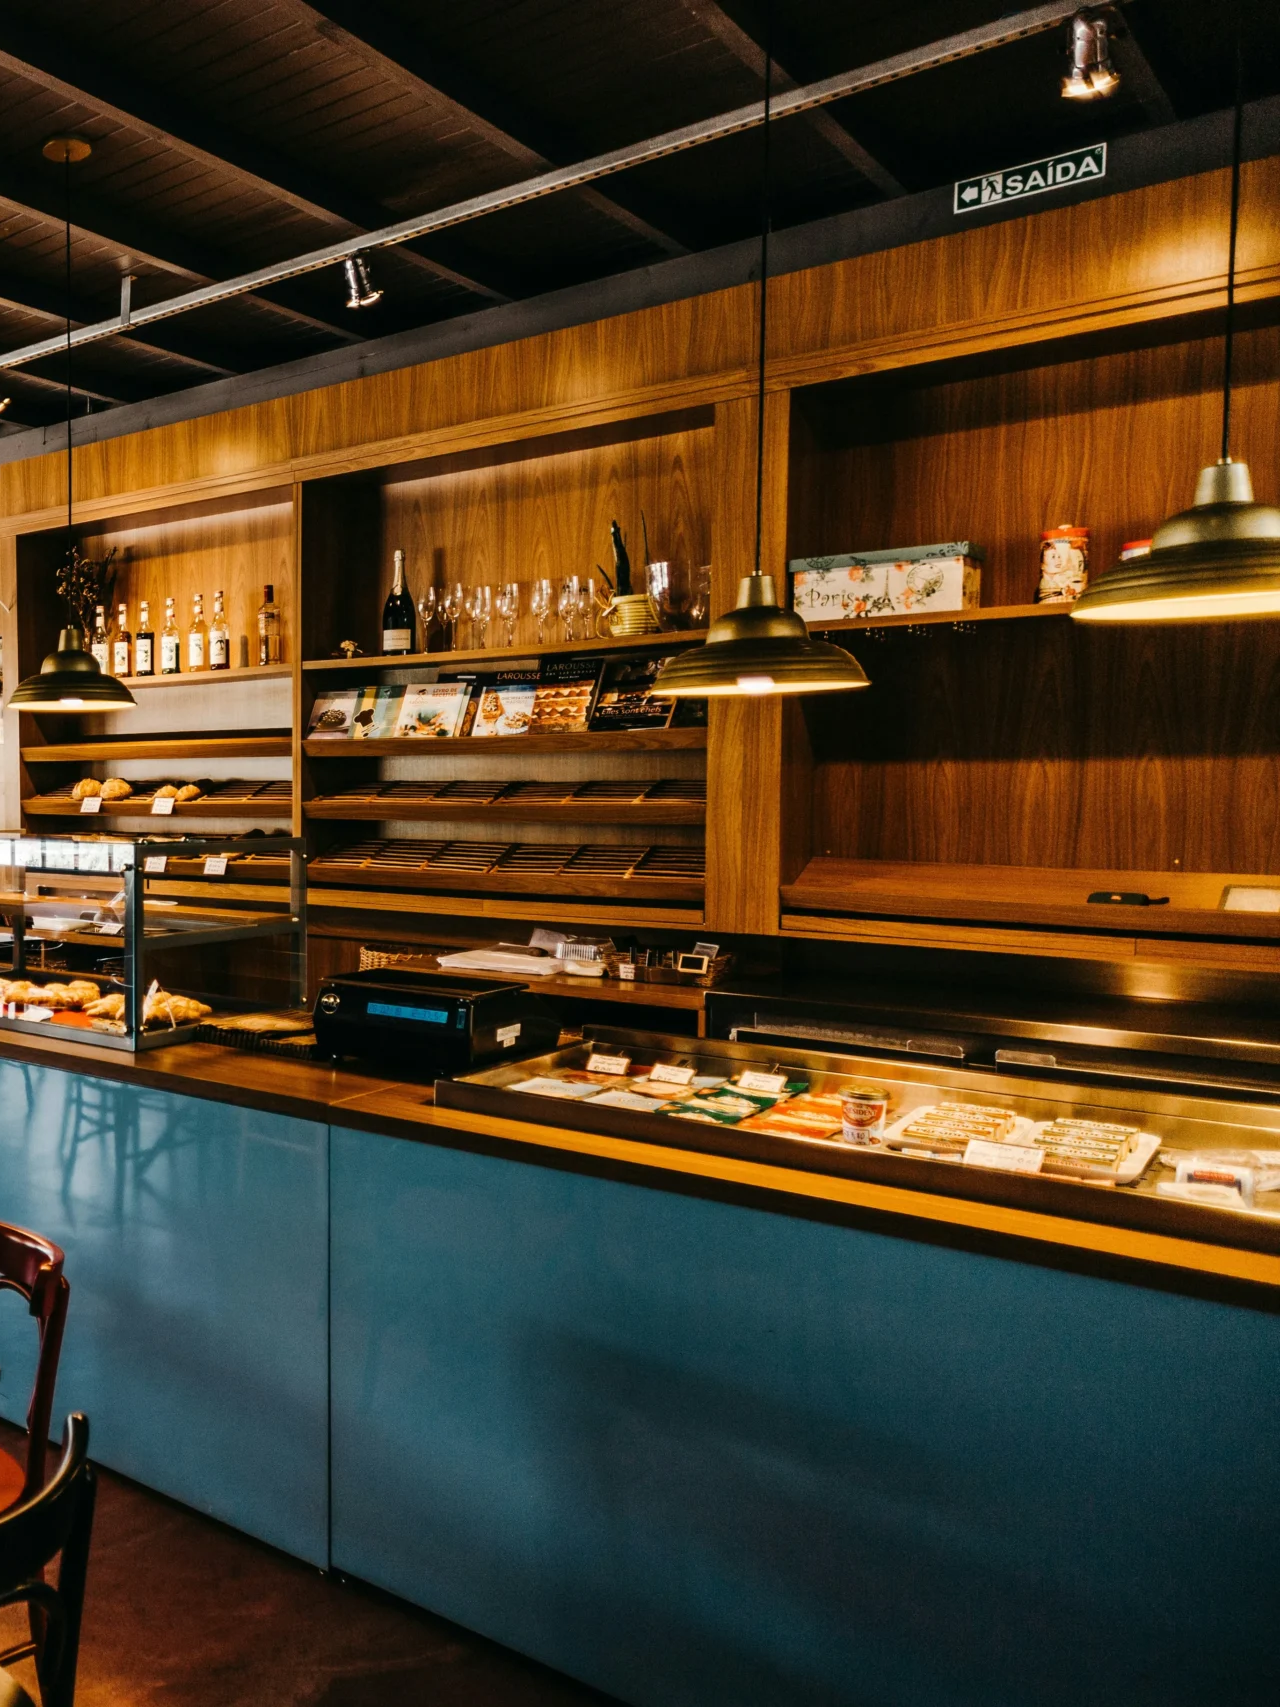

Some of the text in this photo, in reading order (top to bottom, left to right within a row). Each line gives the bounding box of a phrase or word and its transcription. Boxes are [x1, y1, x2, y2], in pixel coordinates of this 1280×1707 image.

[1005, 156, 1099, 195] SAÍDA
[805, 588, 854, 608] Paris
[546, 662, 596, 672] LAROUSSE
[497, 672, 541, 680] LAROUSSE
